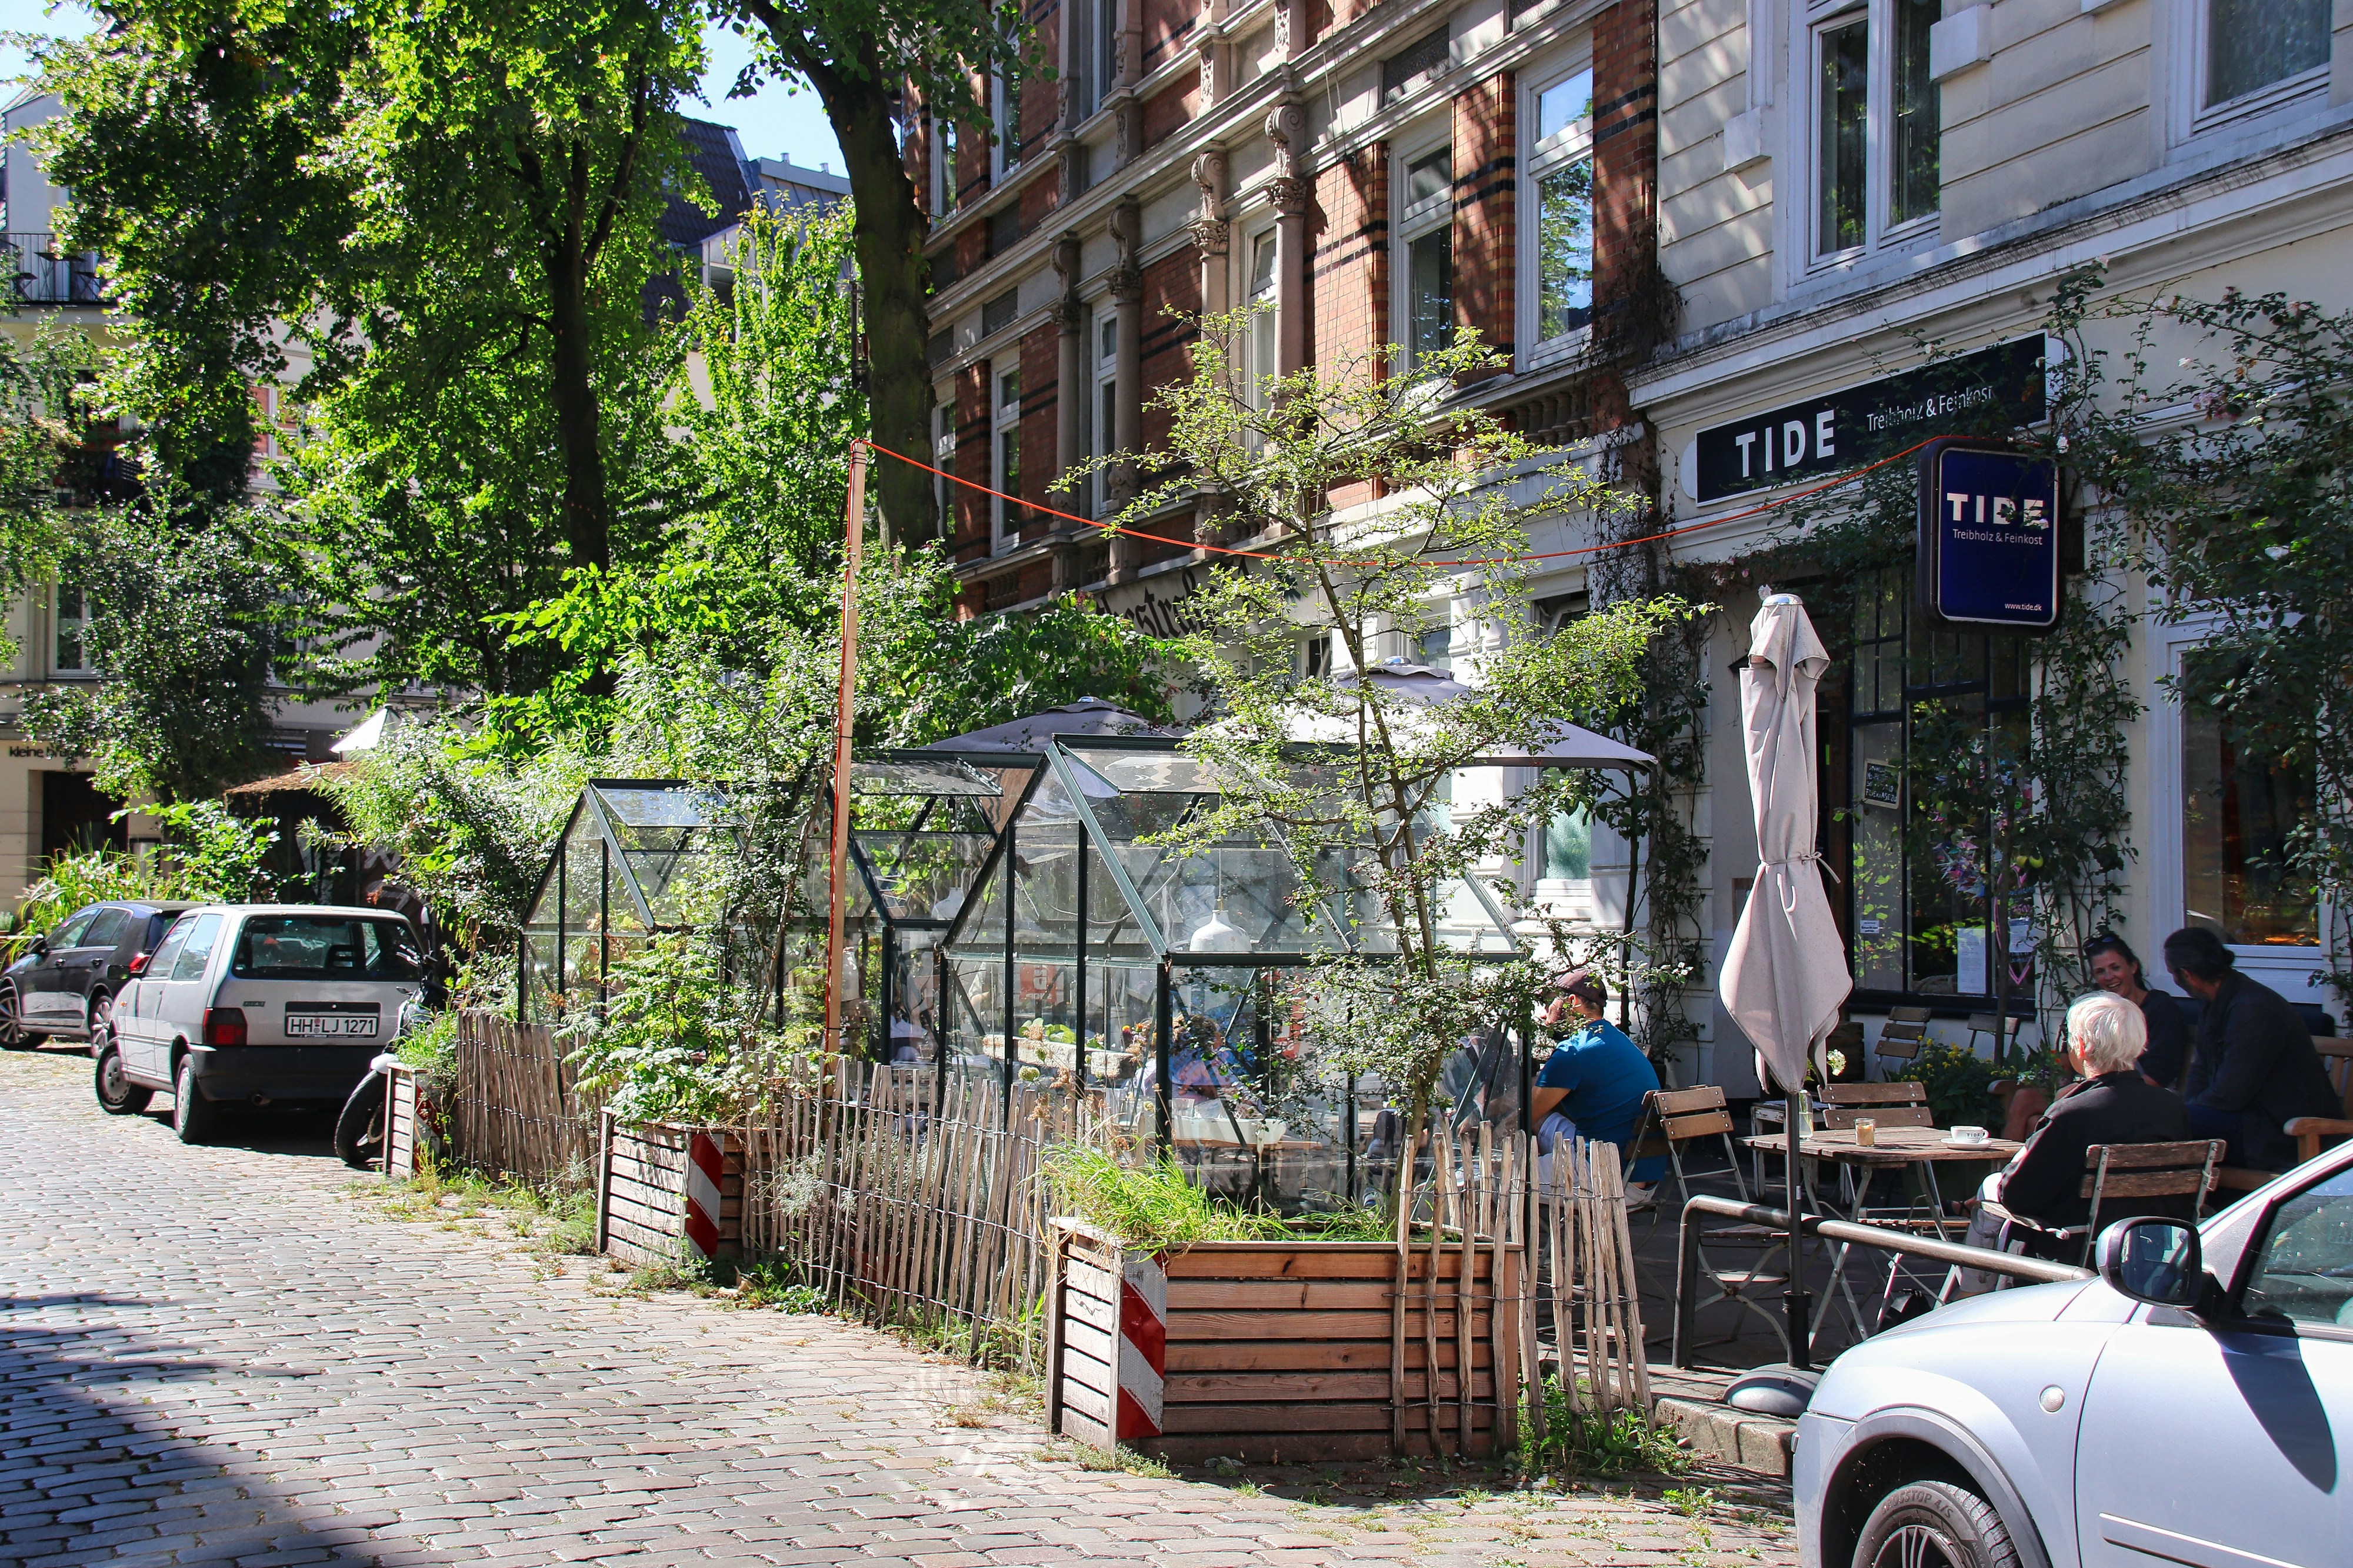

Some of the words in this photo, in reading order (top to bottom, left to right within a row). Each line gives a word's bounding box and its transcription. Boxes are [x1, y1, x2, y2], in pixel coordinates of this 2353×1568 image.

[1926, 398, 1937, 417] &
[1736, 409, 1834, 478] TIDE
[1947, 493, 2044, 526] TIDE
[1953, 529, 1994, 541] Treibholz
[1995, 532, 2002, 542] &
[2005, 533, 2042, 545] Feinkost
[2004, 603, 2042, 611] www.tide.dk
[9, 746, 44, 758] kleine
[345, 1019, 374, 1033] 1271
[1934, 1494, 1954, 1519] 4/S
